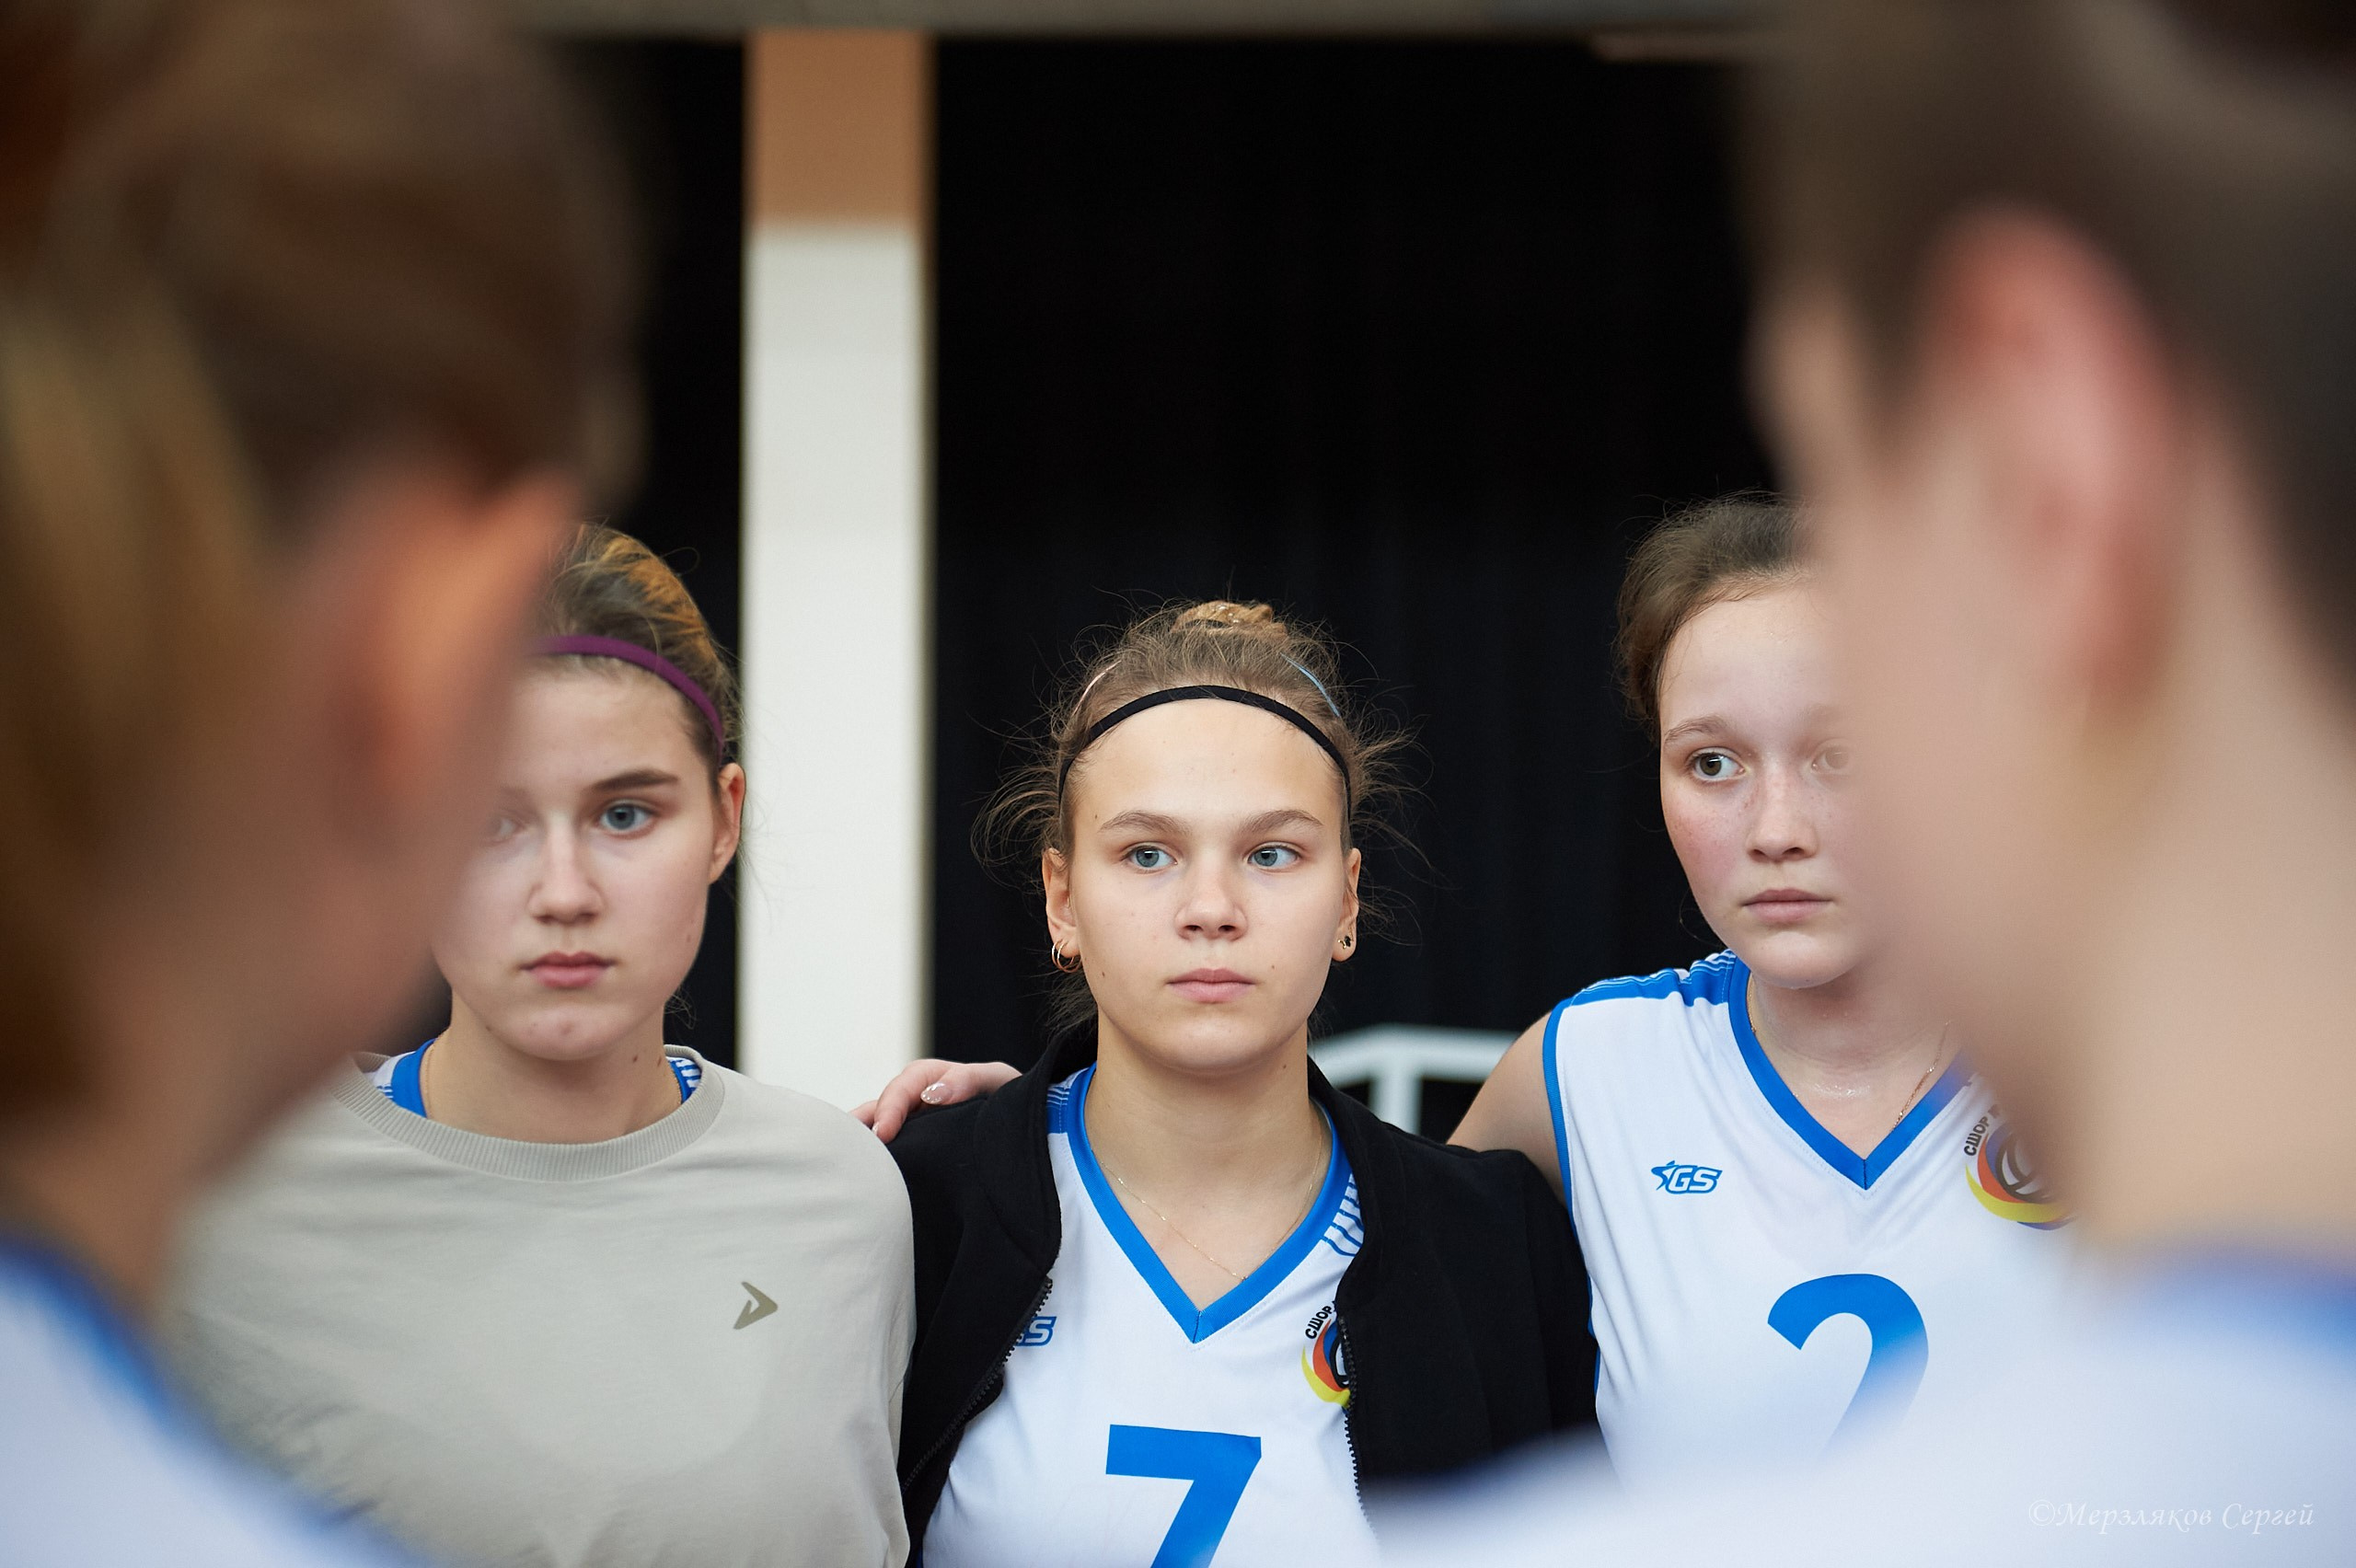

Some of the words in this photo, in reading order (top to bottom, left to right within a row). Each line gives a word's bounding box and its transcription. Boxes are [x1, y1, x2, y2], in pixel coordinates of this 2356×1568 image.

[1964, 1116, 1990, 1156] СШОР
[1663, 1163, 1722, 1194] GS
[1016, 1316, 1057, 1346] S
[1305, 1305, 1333, 1339] СШОР
[1767, 1273, 1929, 1452] 2
[1105, 1424, 1262, 1568] 7
